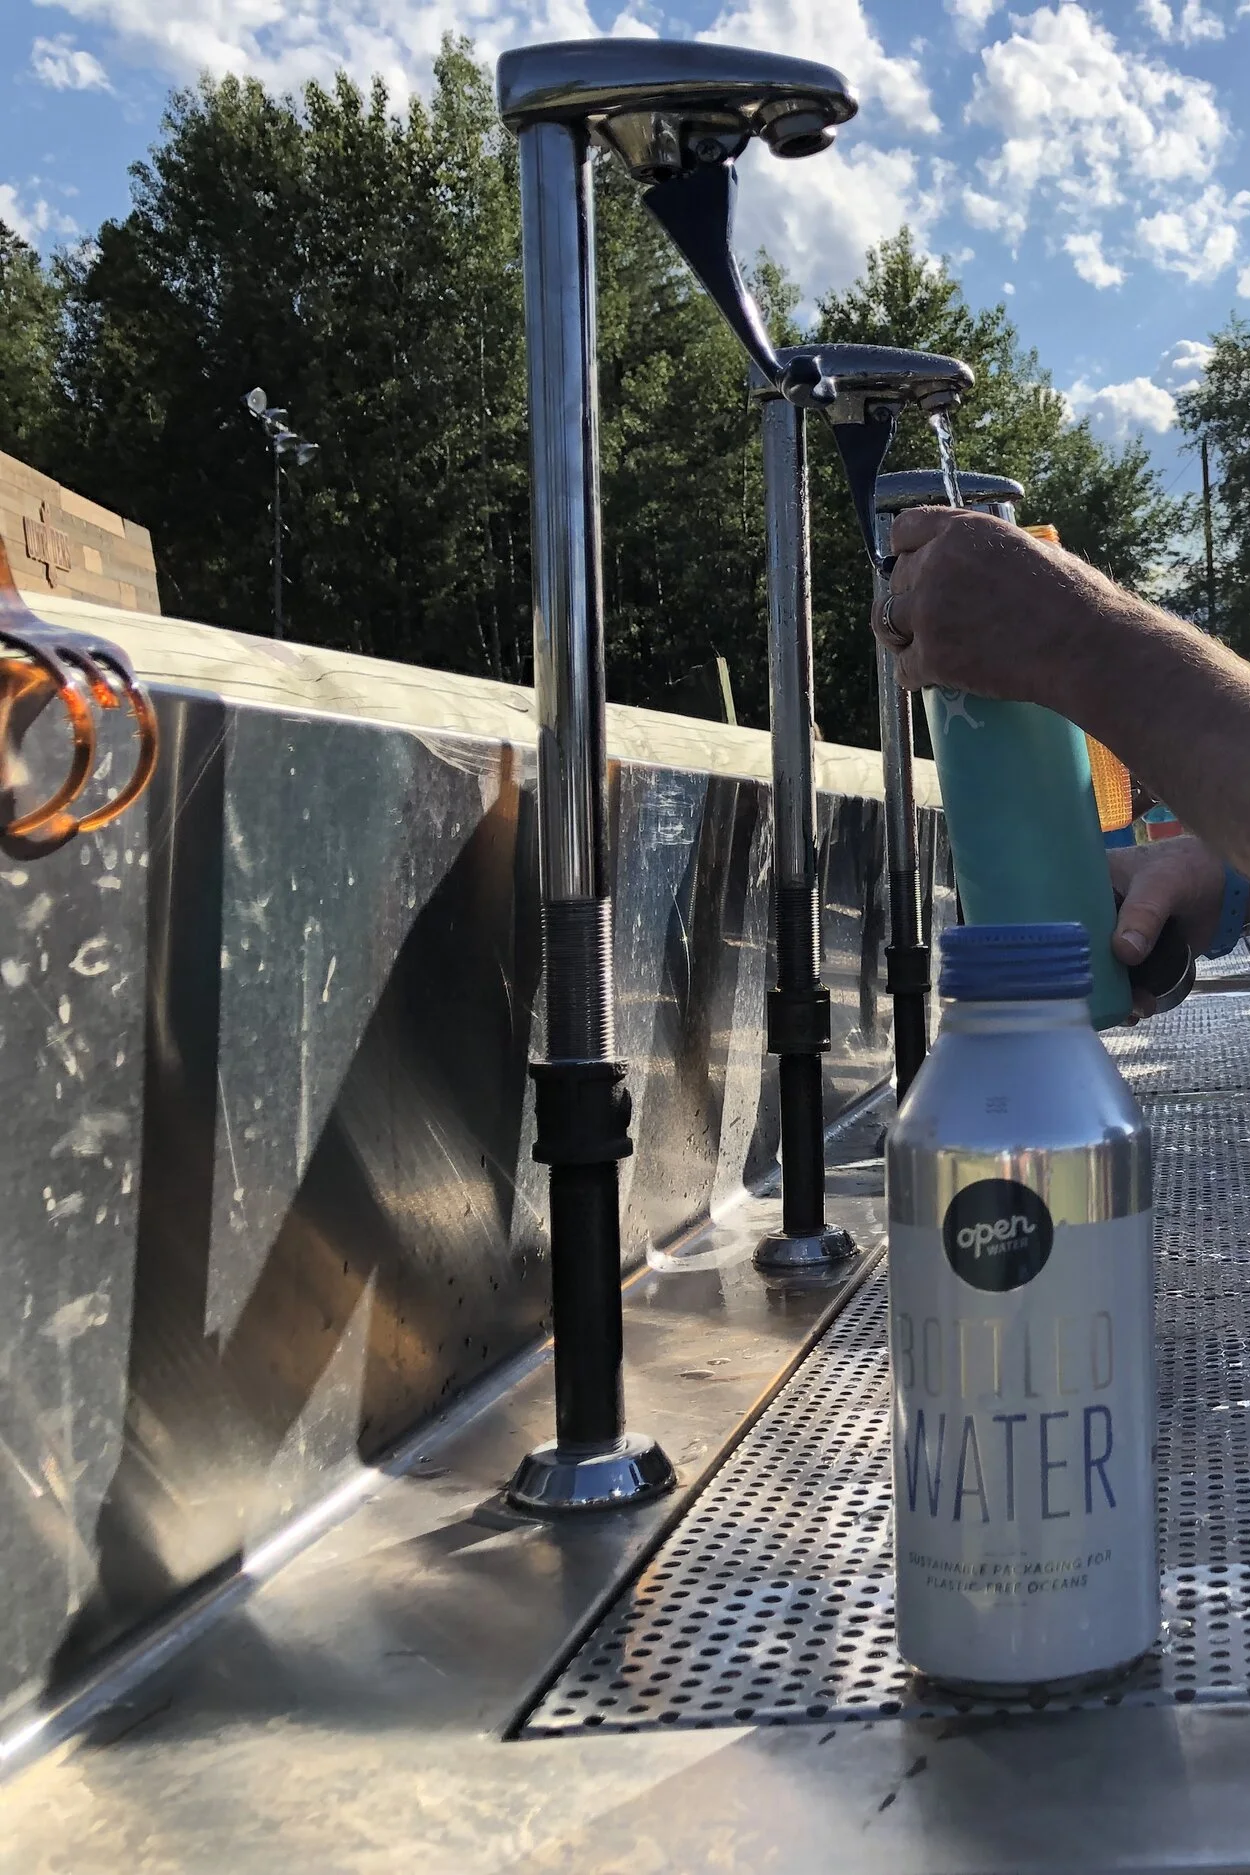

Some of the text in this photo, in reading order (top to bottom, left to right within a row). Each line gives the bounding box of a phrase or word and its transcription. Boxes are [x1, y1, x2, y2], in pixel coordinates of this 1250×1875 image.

[957, 1215, 1036, 1259] open
[986, 1237, 1028, 1256] WATER
[904, 1404, 1117, 1523] WATER
